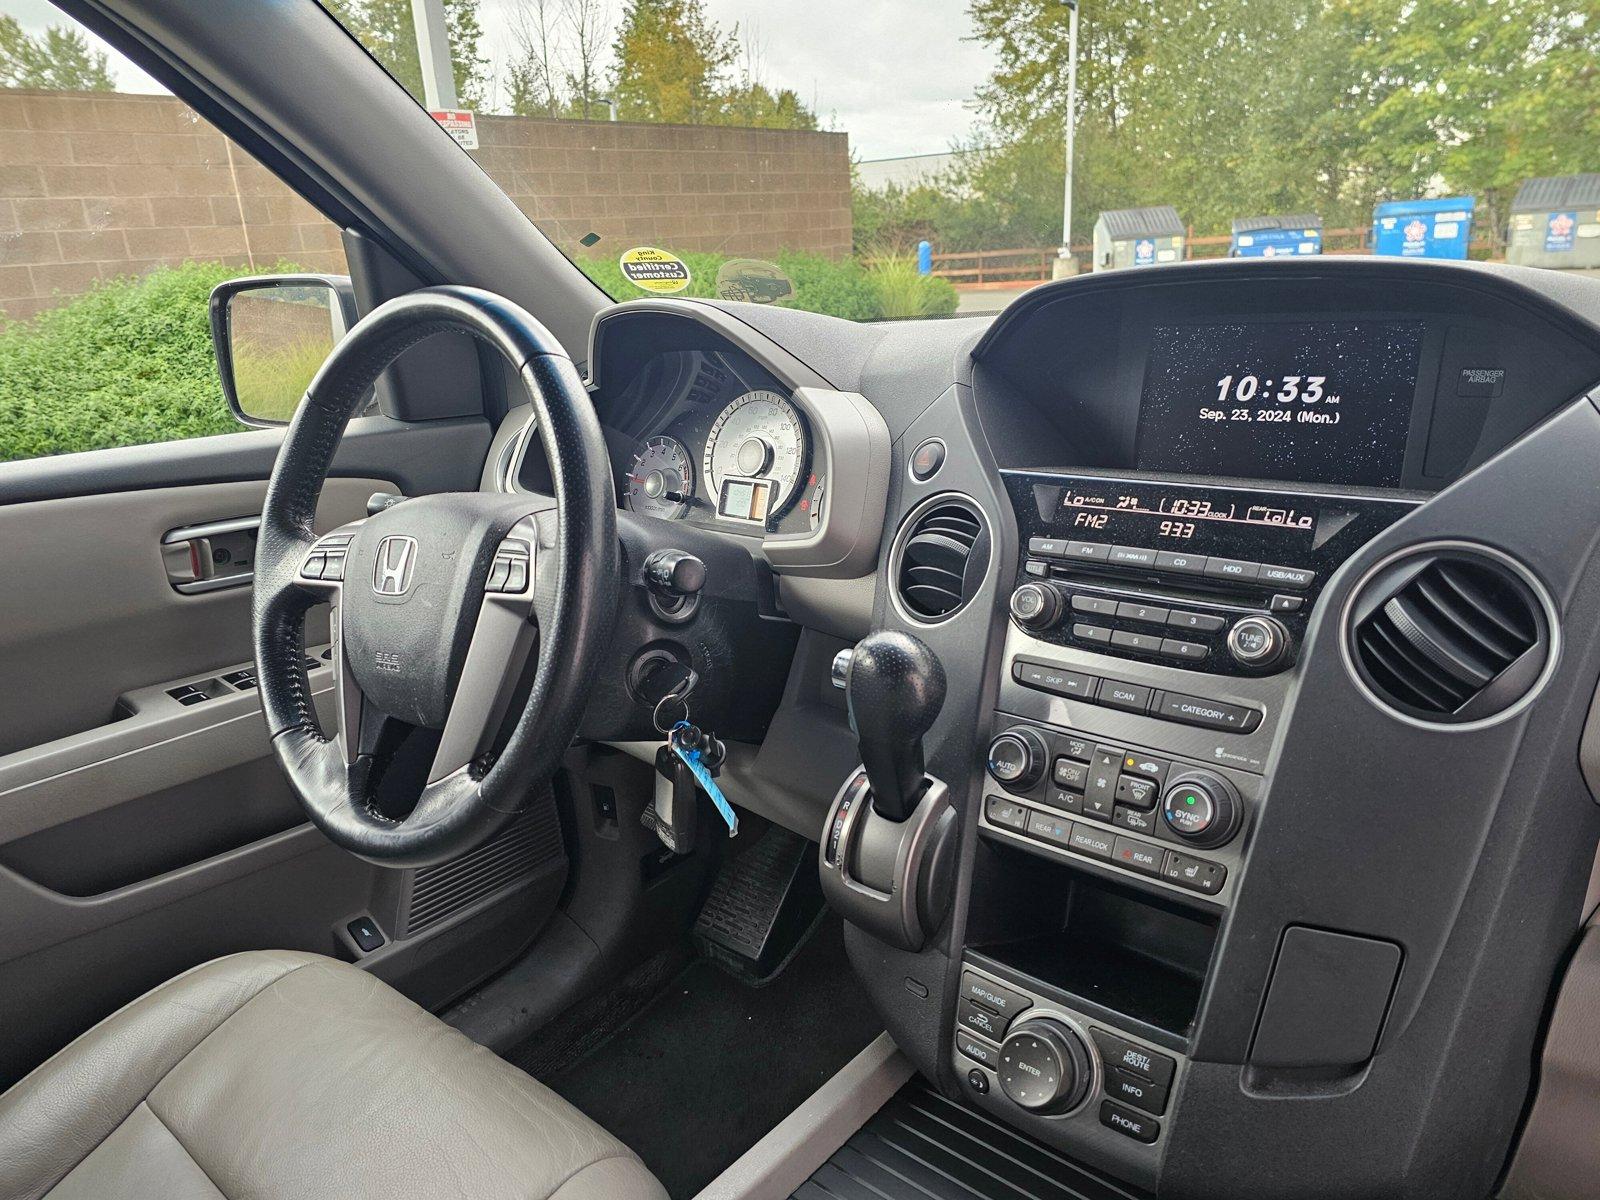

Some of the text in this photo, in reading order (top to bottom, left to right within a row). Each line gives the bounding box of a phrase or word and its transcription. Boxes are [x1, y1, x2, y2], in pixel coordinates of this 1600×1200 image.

[1462, 369, 1505, 378] PASSENGER
[1468, 376, 1497, 384] AIRBAG
[1217, 375, 1340, 404] 10:33 AM
[768, 407, 779, 416] 80
[1199, 408, 1341, 424] Sep. 23, 2024 (Mon.)
[780, 422, 792, 431] 100
[650, 450, 656, 458] 3
[671, 453, 677, 461] 5
[1171, 499, 1212, 516] 10:33
[1074, 512, 1109, 529] FM2
[1081, 546, 1094, 554] FM
[1173, 558, 1187, 566] CD
[1222, 564, 1243, 574] HDD
[1266, 569, 1306, 582] USB/AUX
[1138, 609, 1146, 617] 2
[1190, 617, 1197, 625] 3
[1240, 632, 1263, 643] TUNE
[1181, 645, 1188, 653] 6
[1045, 675, 1063, 685] SKIP
[1113, 690, 1136, 702] SCAN
[1181, 704, 1225, 720] CATEGORY
[996, 760, 1016, 771] AUTO
[1130, 781, 1151, 790] FRONT
[1058, 793, 1074, 803] A/C
[843, 801, 851, 810] R
[1175, 809, 1200, 823] SYNC
[1035, 822, 1052, 833] REAR
[834, 831, 840, 840] 2
[1075, 835, 1109, 852] REAR LOCK
[1133, 852, 1153, 865] REAR
[1169, 869, 1179, 877] LO
[1202, 880, 1211, 888] HI
[971, 986, 1007, 1008] MAP/GUIDE
[968, 1015, 994, 1033] CANCEL
[966, 1044, 987, 1060] AUDIO
[1126, 1050, 1151, 1064] DEST/
[1122, 1055, 1151, 1072] ROUTE
[1018, 1062, 1041, 1078] ENTER
[1121, 1083, 1143, 1098] INFO
[1111, 1113, 1142, 1133] PHONE
